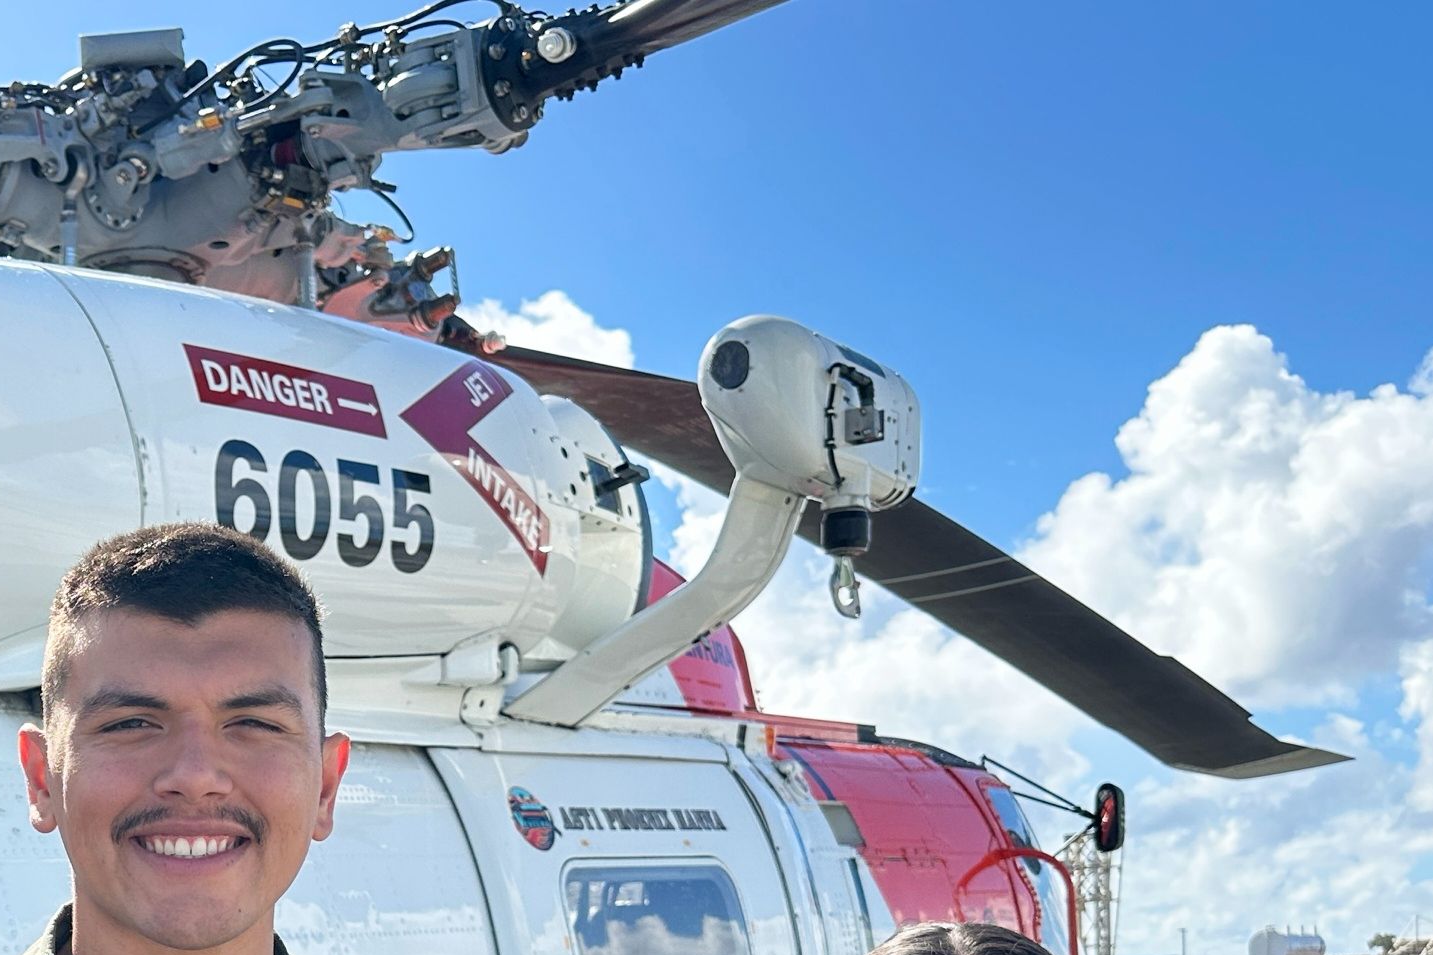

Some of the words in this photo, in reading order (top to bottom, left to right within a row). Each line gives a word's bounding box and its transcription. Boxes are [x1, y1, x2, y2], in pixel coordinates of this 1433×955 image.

[200, 359, 333, 415] DANGER
[463, 370, 494, 408] JET
[215, 439, 435, 573] 6055
[467, 447, 543, 550] INTAKE
